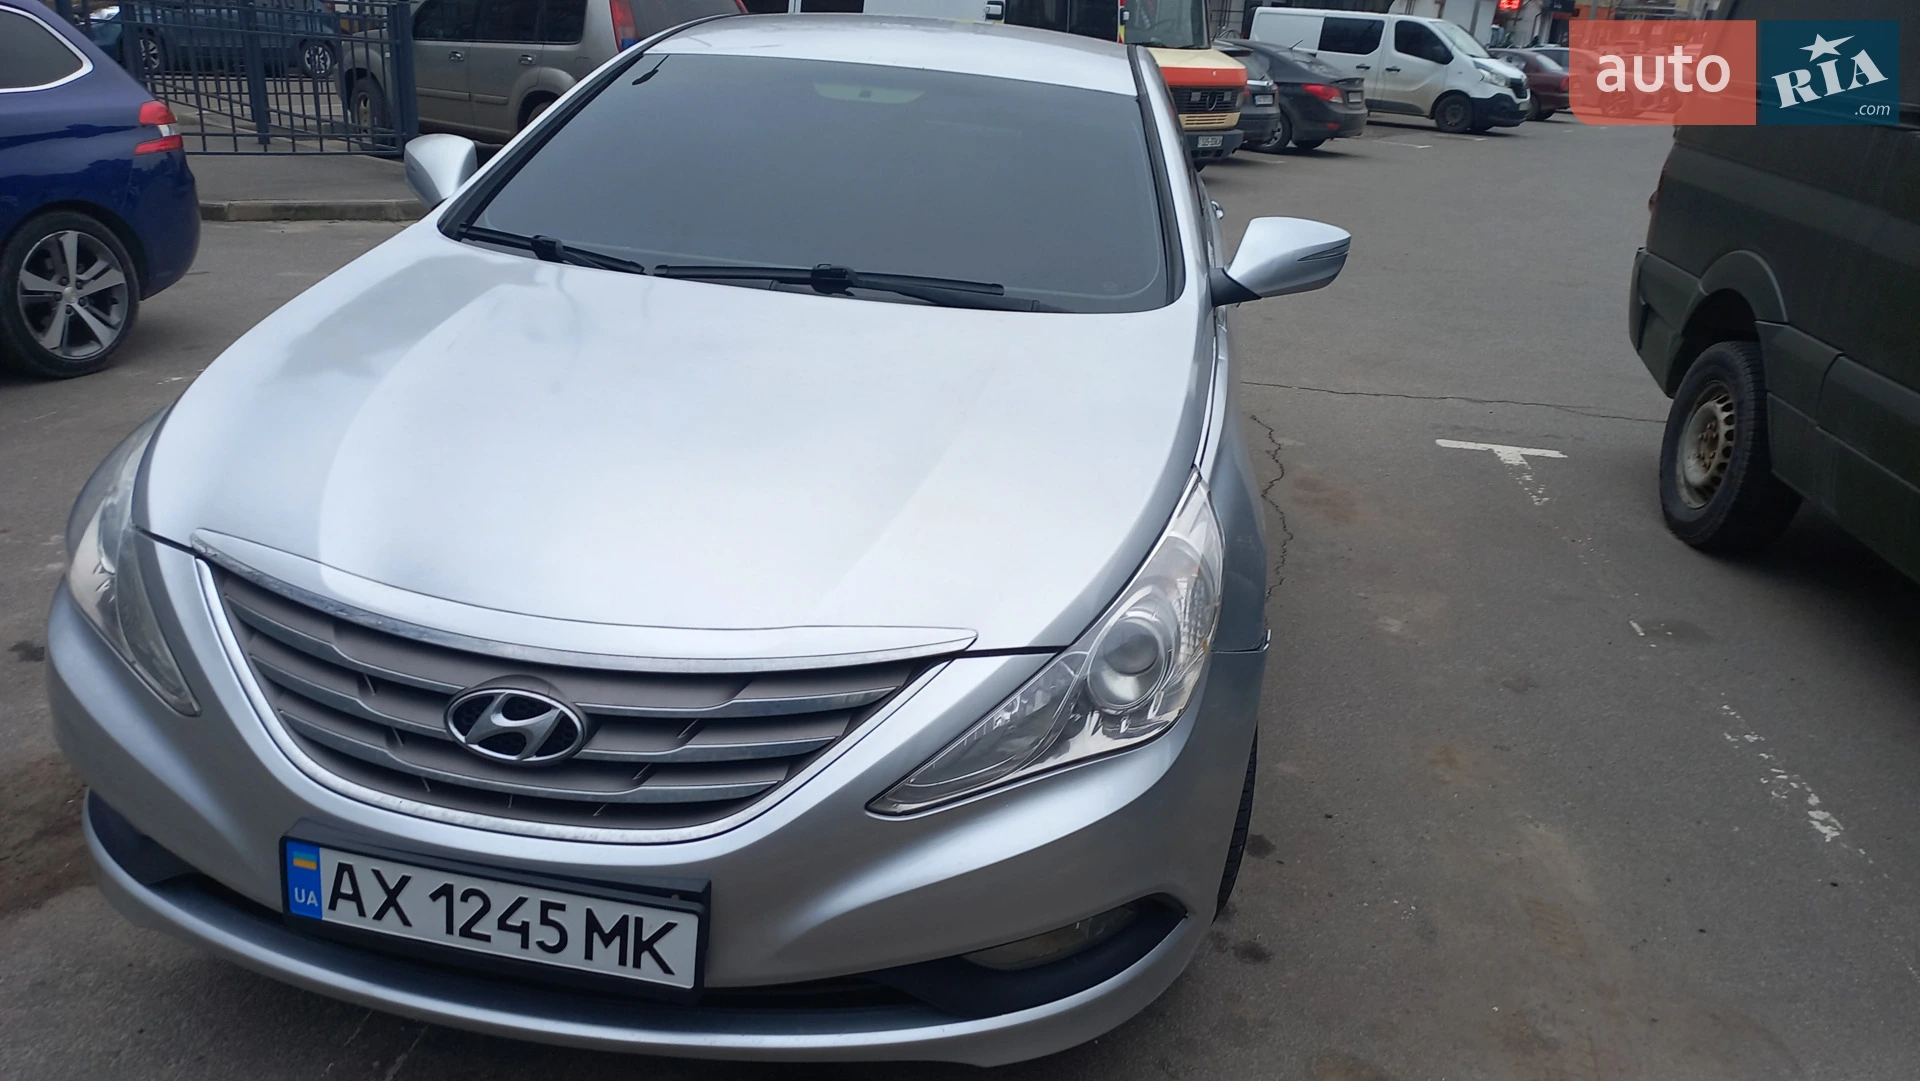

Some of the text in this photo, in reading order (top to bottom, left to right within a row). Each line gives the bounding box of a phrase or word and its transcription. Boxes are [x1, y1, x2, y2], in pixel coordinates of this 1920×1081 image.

[294, 887, 319, 907] UA
[327, 862, 679, 975] AX 1245 MK
